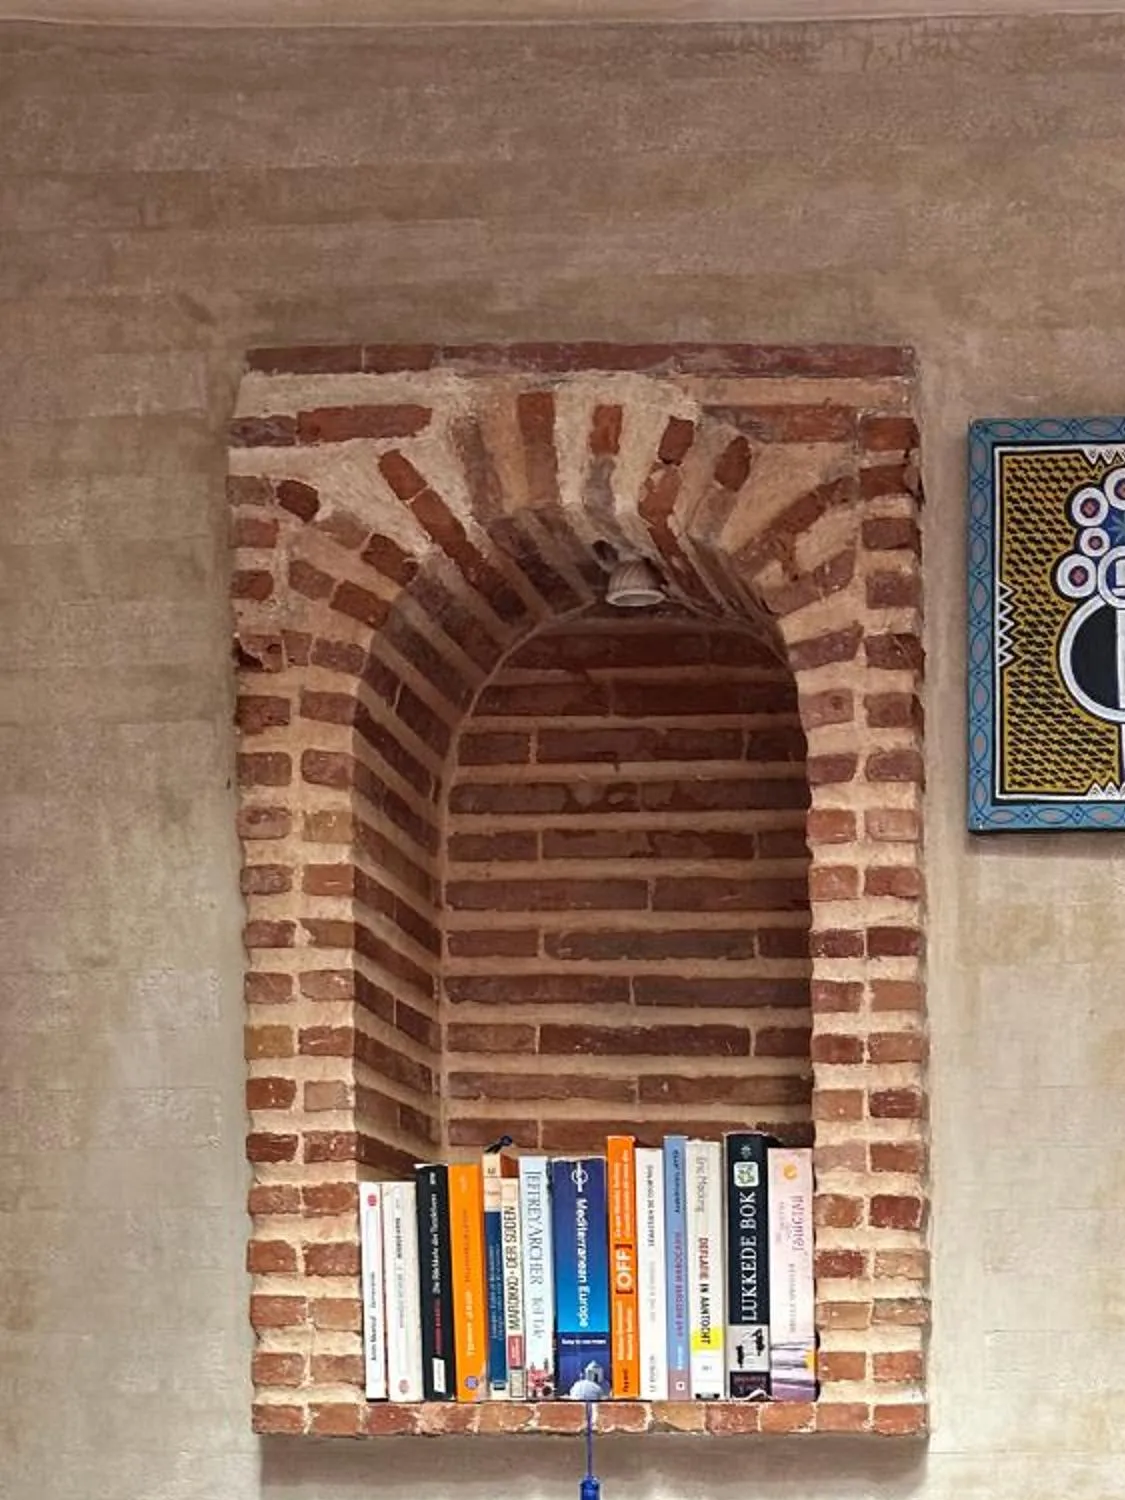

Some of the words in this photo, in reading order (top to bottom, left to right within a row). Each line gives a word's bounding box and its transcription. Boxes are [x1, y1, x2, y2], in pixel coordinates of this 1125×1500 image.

[525, 1171, 542, 1225] JEFFREY
[740, 1191, 757, 1230] BOK
[506, 1245, 517, 1269] DER
[527, 1225, 544, 1285] ARCHER
[575, 1198, 588, 1283] Mediterranean
[741, 1236, 757, 1322] LUKKEDE
[577, 1286, 591, 1329] Europe
[700, 1295, 711, 1345] AANTOCHT
